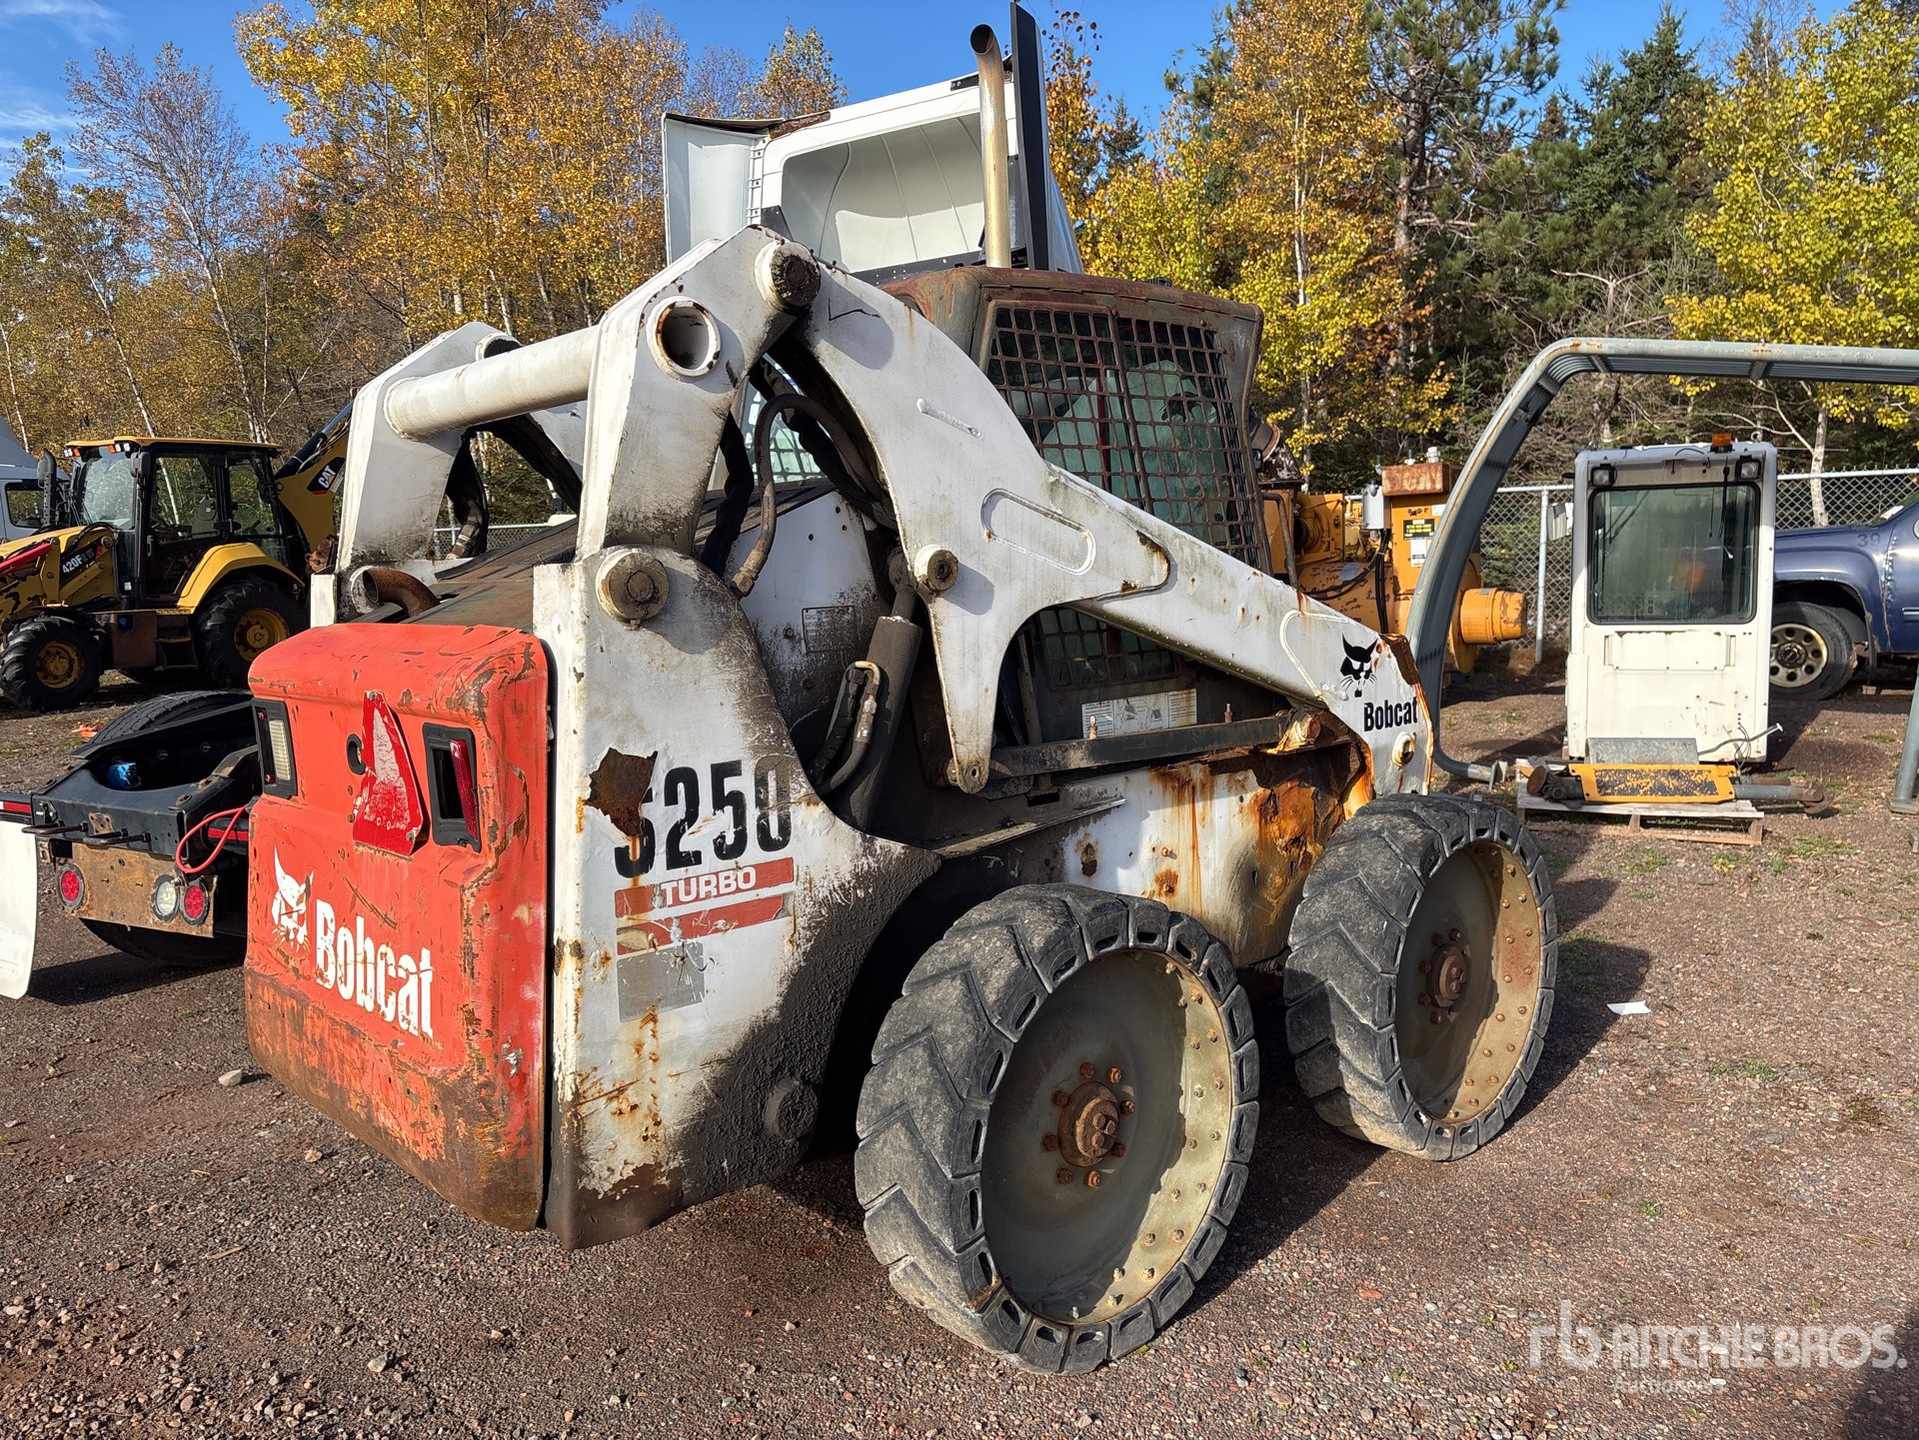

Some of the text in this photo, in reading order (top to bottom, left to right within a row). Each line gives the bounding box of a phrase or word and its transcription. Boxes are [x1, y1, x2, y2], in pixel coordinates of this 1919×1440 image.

[318, 465, 336, 488] CAT
[1857, 532, 1881, 547] 39
[1364, 697, 1417, 732] Bobcat
[660, 866, 757, 905] TURBO
[315, 898, 434, 1040] Bobcat
